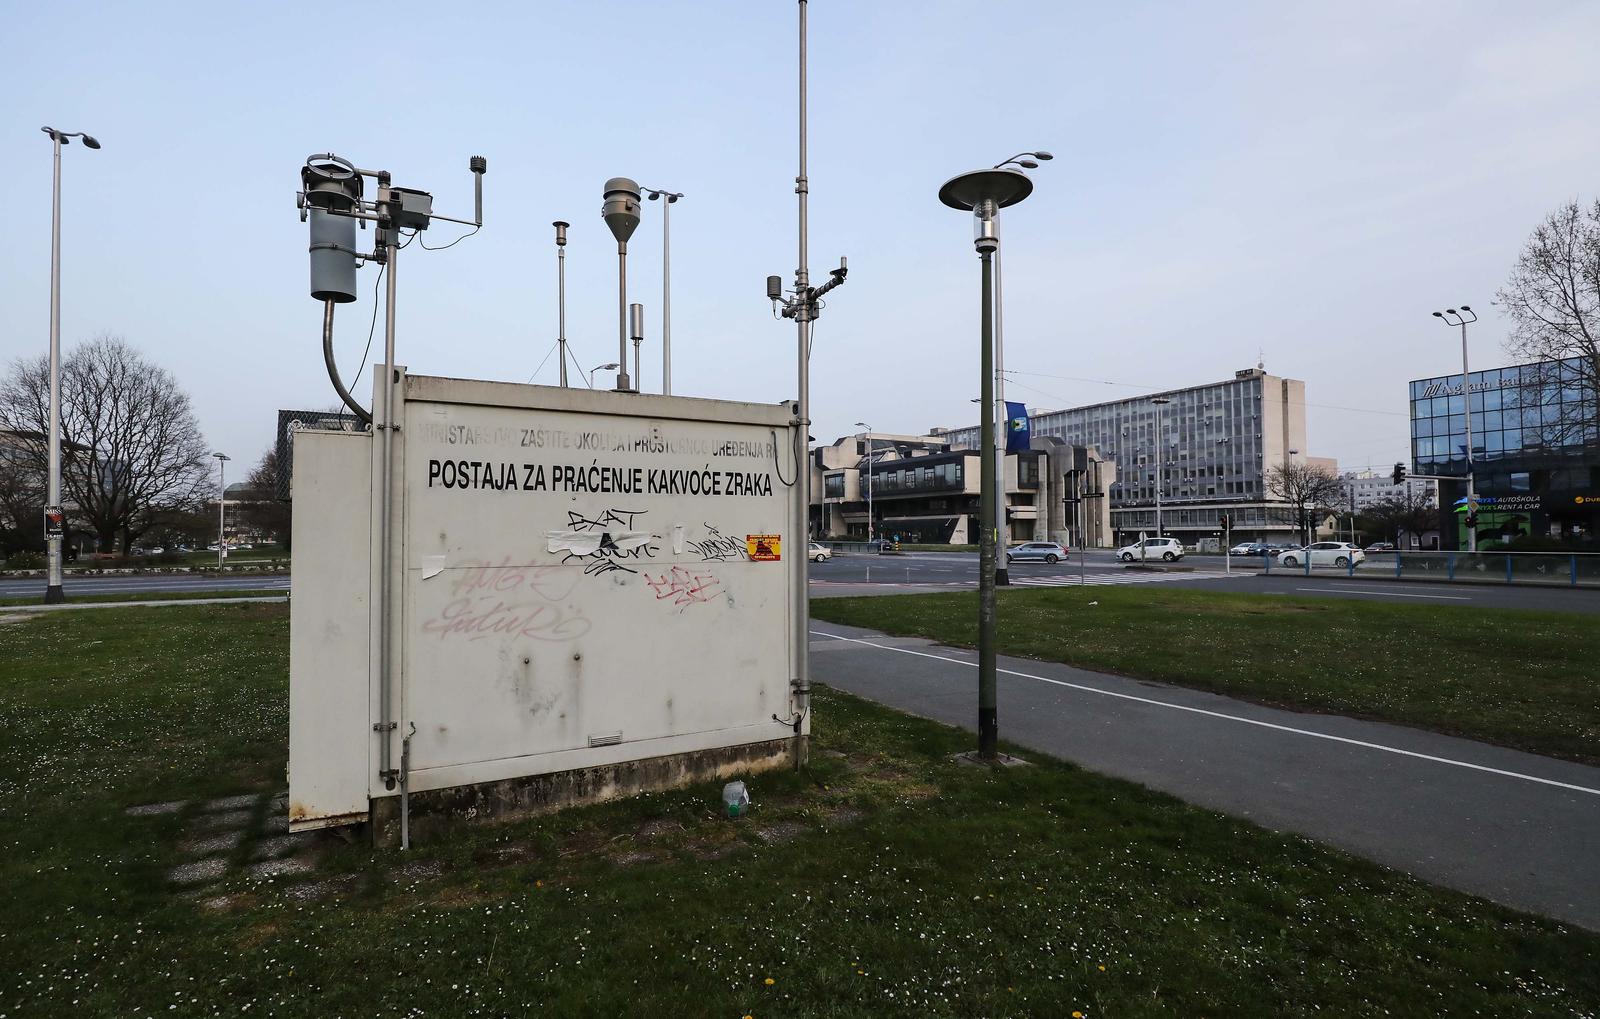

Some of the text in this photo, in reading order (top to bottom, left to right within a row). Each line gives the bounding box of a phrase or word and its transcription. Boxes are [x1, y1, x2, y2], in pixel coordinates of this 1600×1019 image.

[428, 458, 773, 497] POSTAJA ZA PRAĆENJE KAKVOĆE ZRAKA
